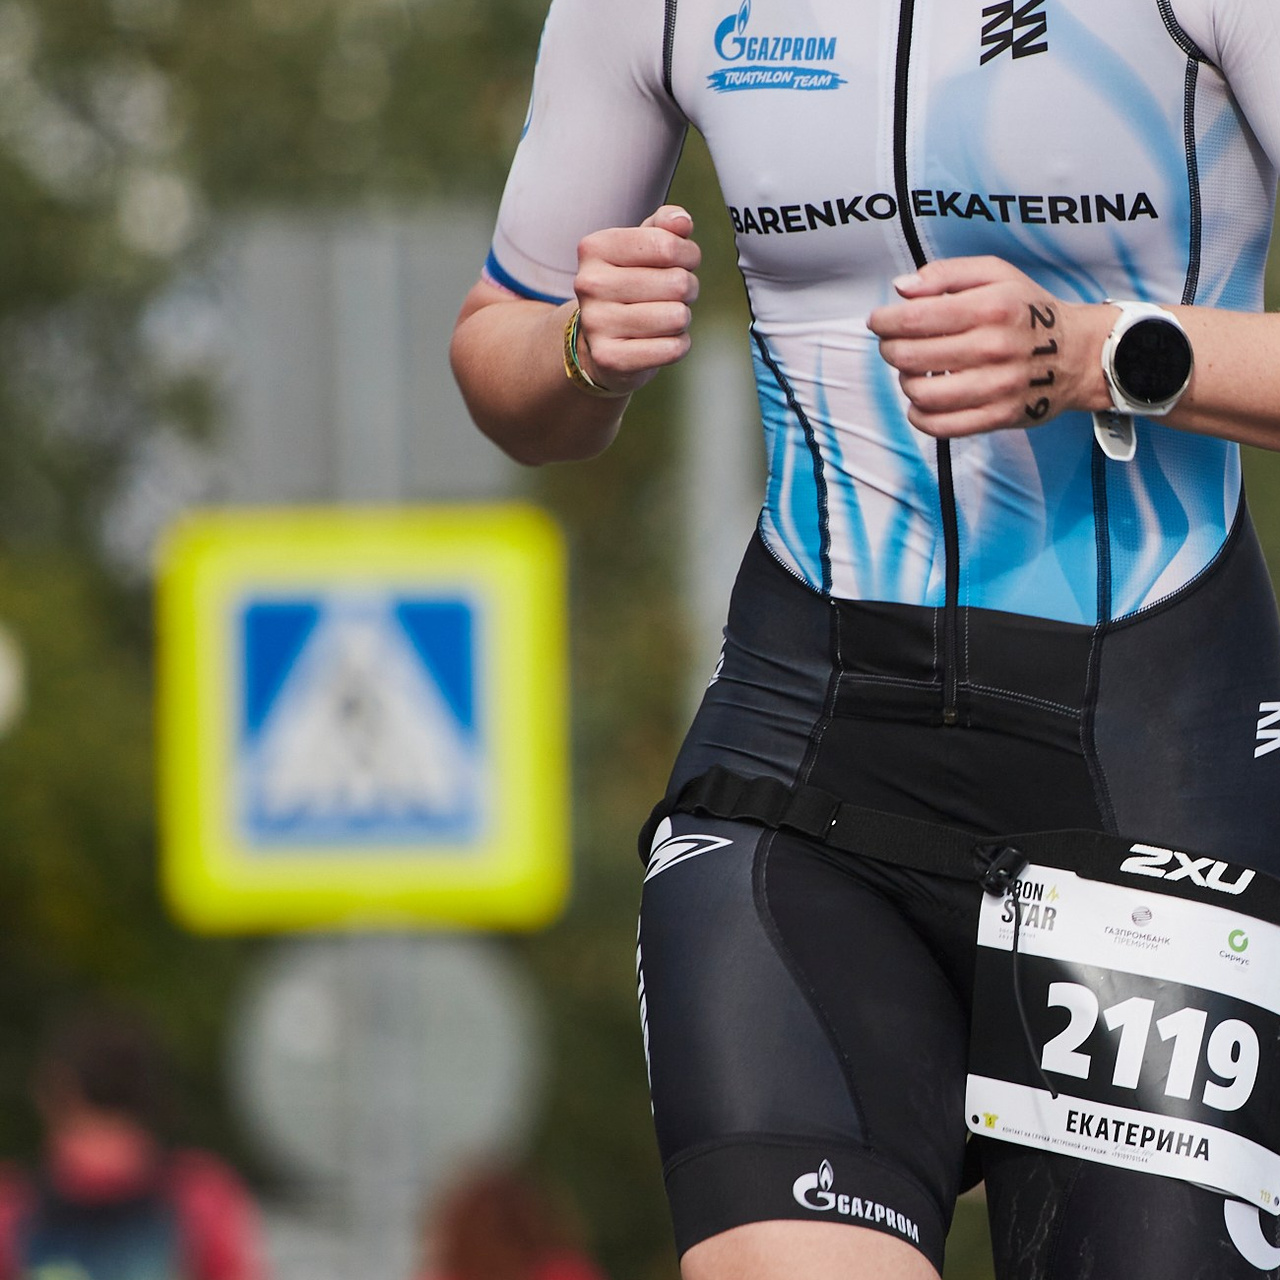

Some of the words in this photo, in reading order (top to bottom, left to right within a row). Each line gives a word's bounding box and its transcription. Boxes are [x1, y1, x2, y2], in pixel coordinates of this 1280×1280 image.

[746, 36, 837, 61] GAZPROM
[724, 70, 794, 86] TRIATHLON
[793, 74, 833, 88] TEAM
[727, 193, 897, 234] BARENKO
[911, 189, 1159, 224] EKATERINA
[1025, 303, 1058, 420] 2119
[1120, 843, 1256, 895] 2XU
[1001, 899, 1057, 931] STAR
[1104, 926, 1170, 945] ГАЗПРОМБАНК
[1113, 936, 1159, 951] ПРЕМИУМ
[1219, 950, 1250, 965] Сириус
[1041, 982, 1260, 1112] 2119
[1066, 1109, 1209, 1161] ЕКАТЕРИНА
[837, 1193, 920, 1243] GAZPROM
